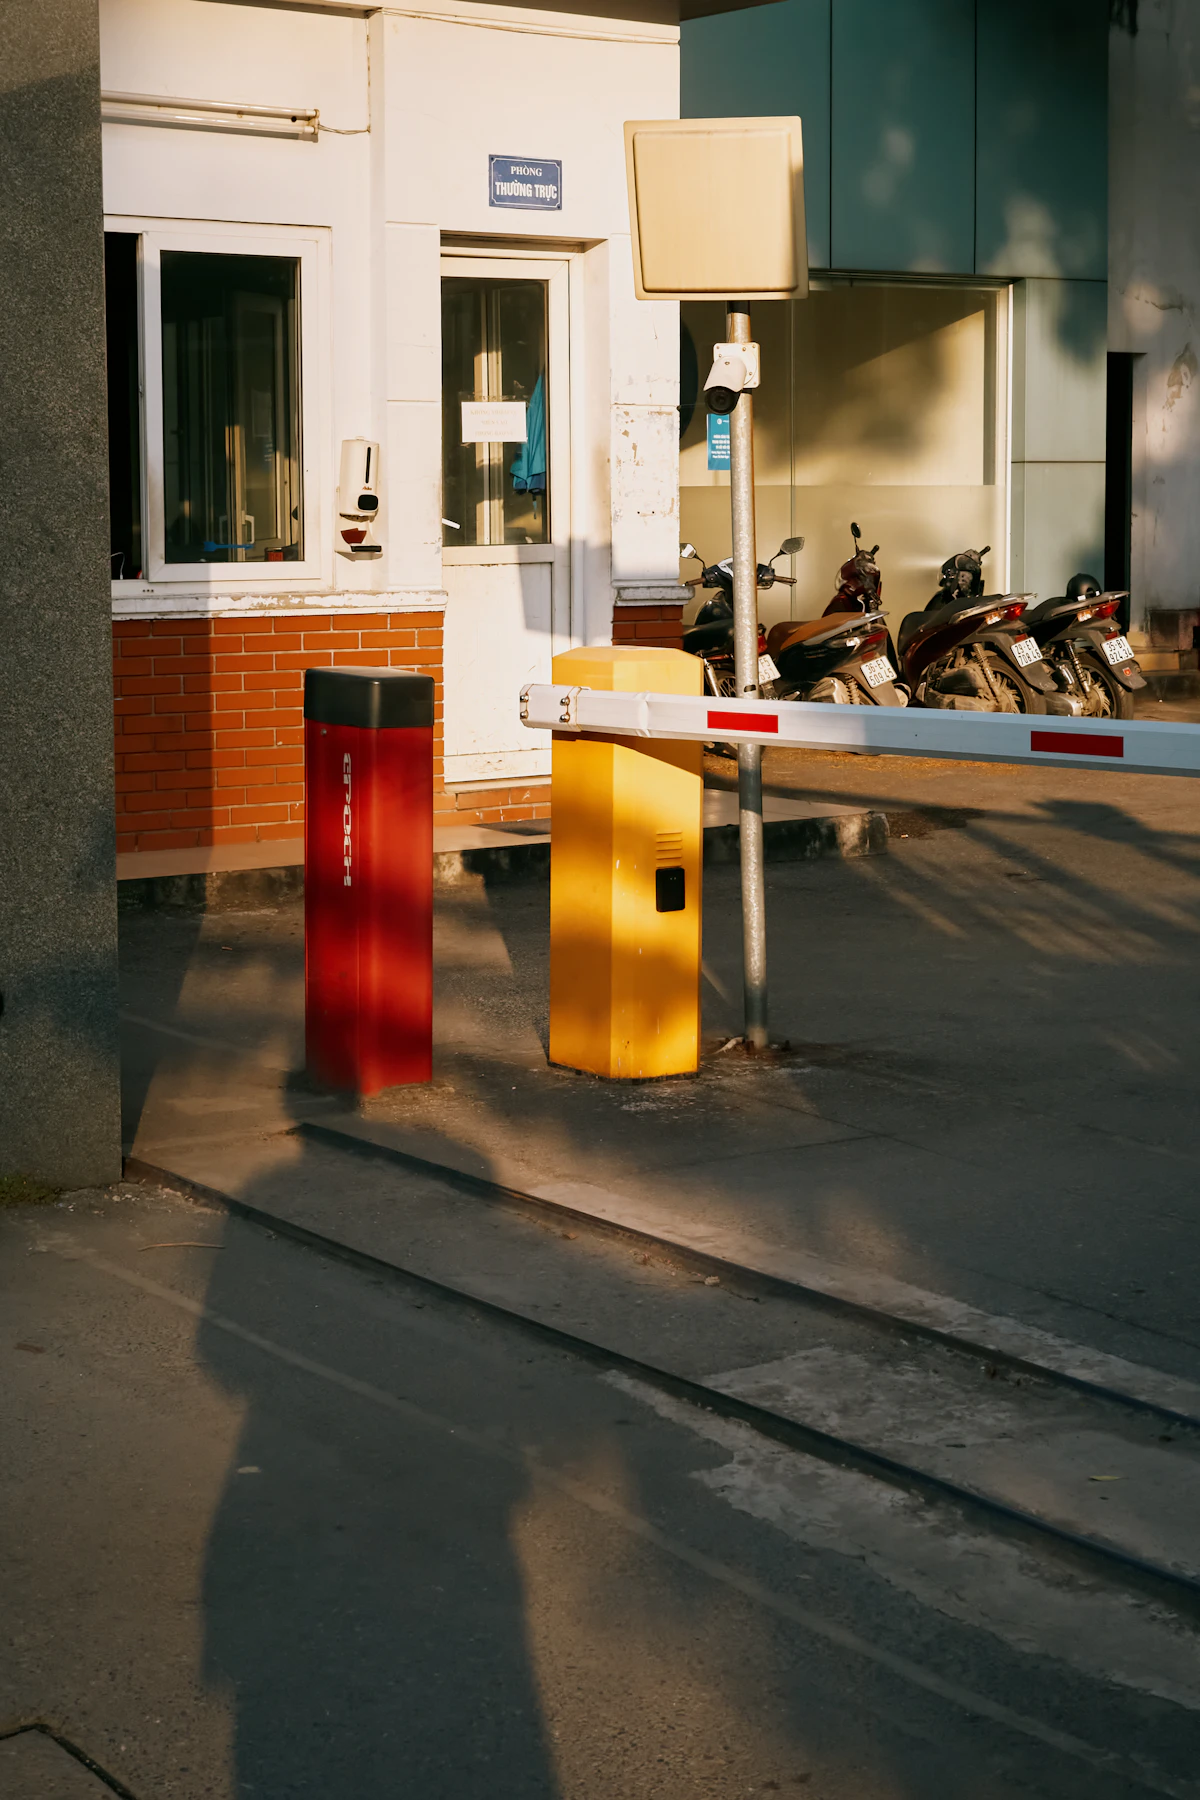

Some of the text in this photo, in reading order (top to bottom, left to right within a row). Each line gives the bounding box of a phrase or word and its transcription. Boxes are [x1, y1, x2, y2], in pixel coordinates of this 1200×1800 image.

[510, 165, 543, 177] PHÒNG
[495, 179, 558, 202] THƯỜNG TRỰC
